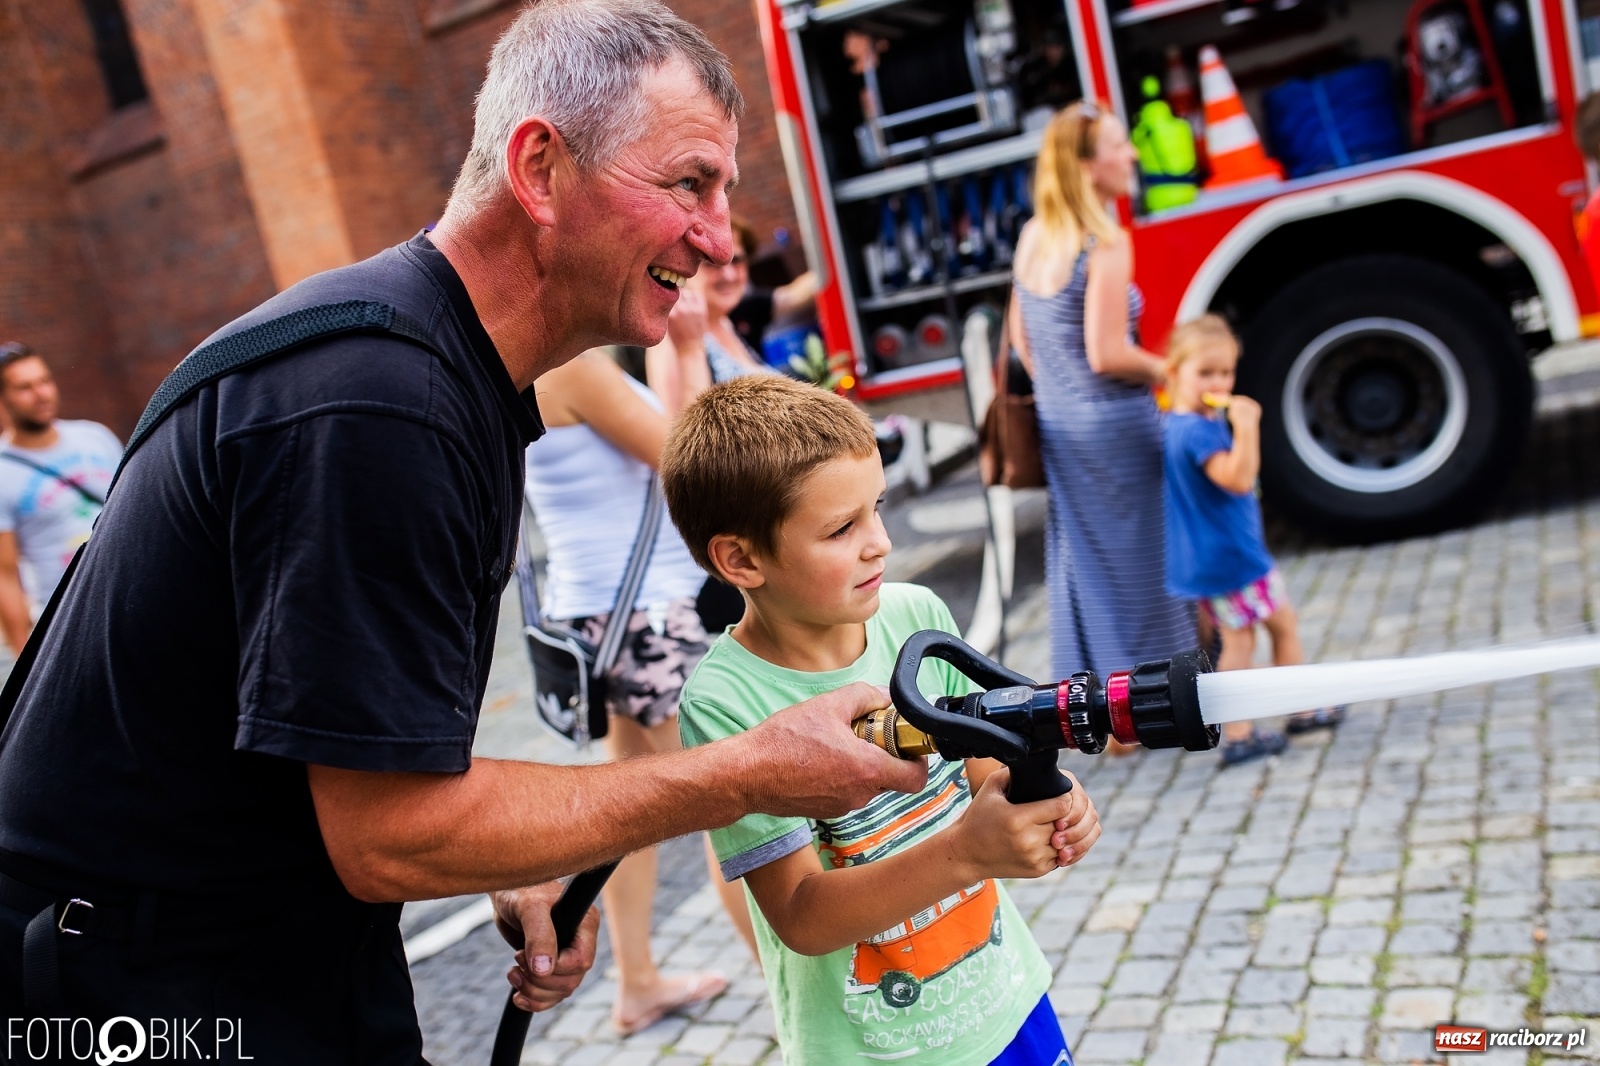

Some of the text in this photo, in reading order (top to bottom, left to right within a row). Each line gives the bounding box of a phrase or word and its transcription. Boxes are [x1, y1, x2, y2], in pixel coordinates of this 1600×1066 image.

[843, 995, 911, 1025] EAS
[919, 949, 990, 1012] COAST
[863, 1003, 969, 1048] ROCKAWAYS
